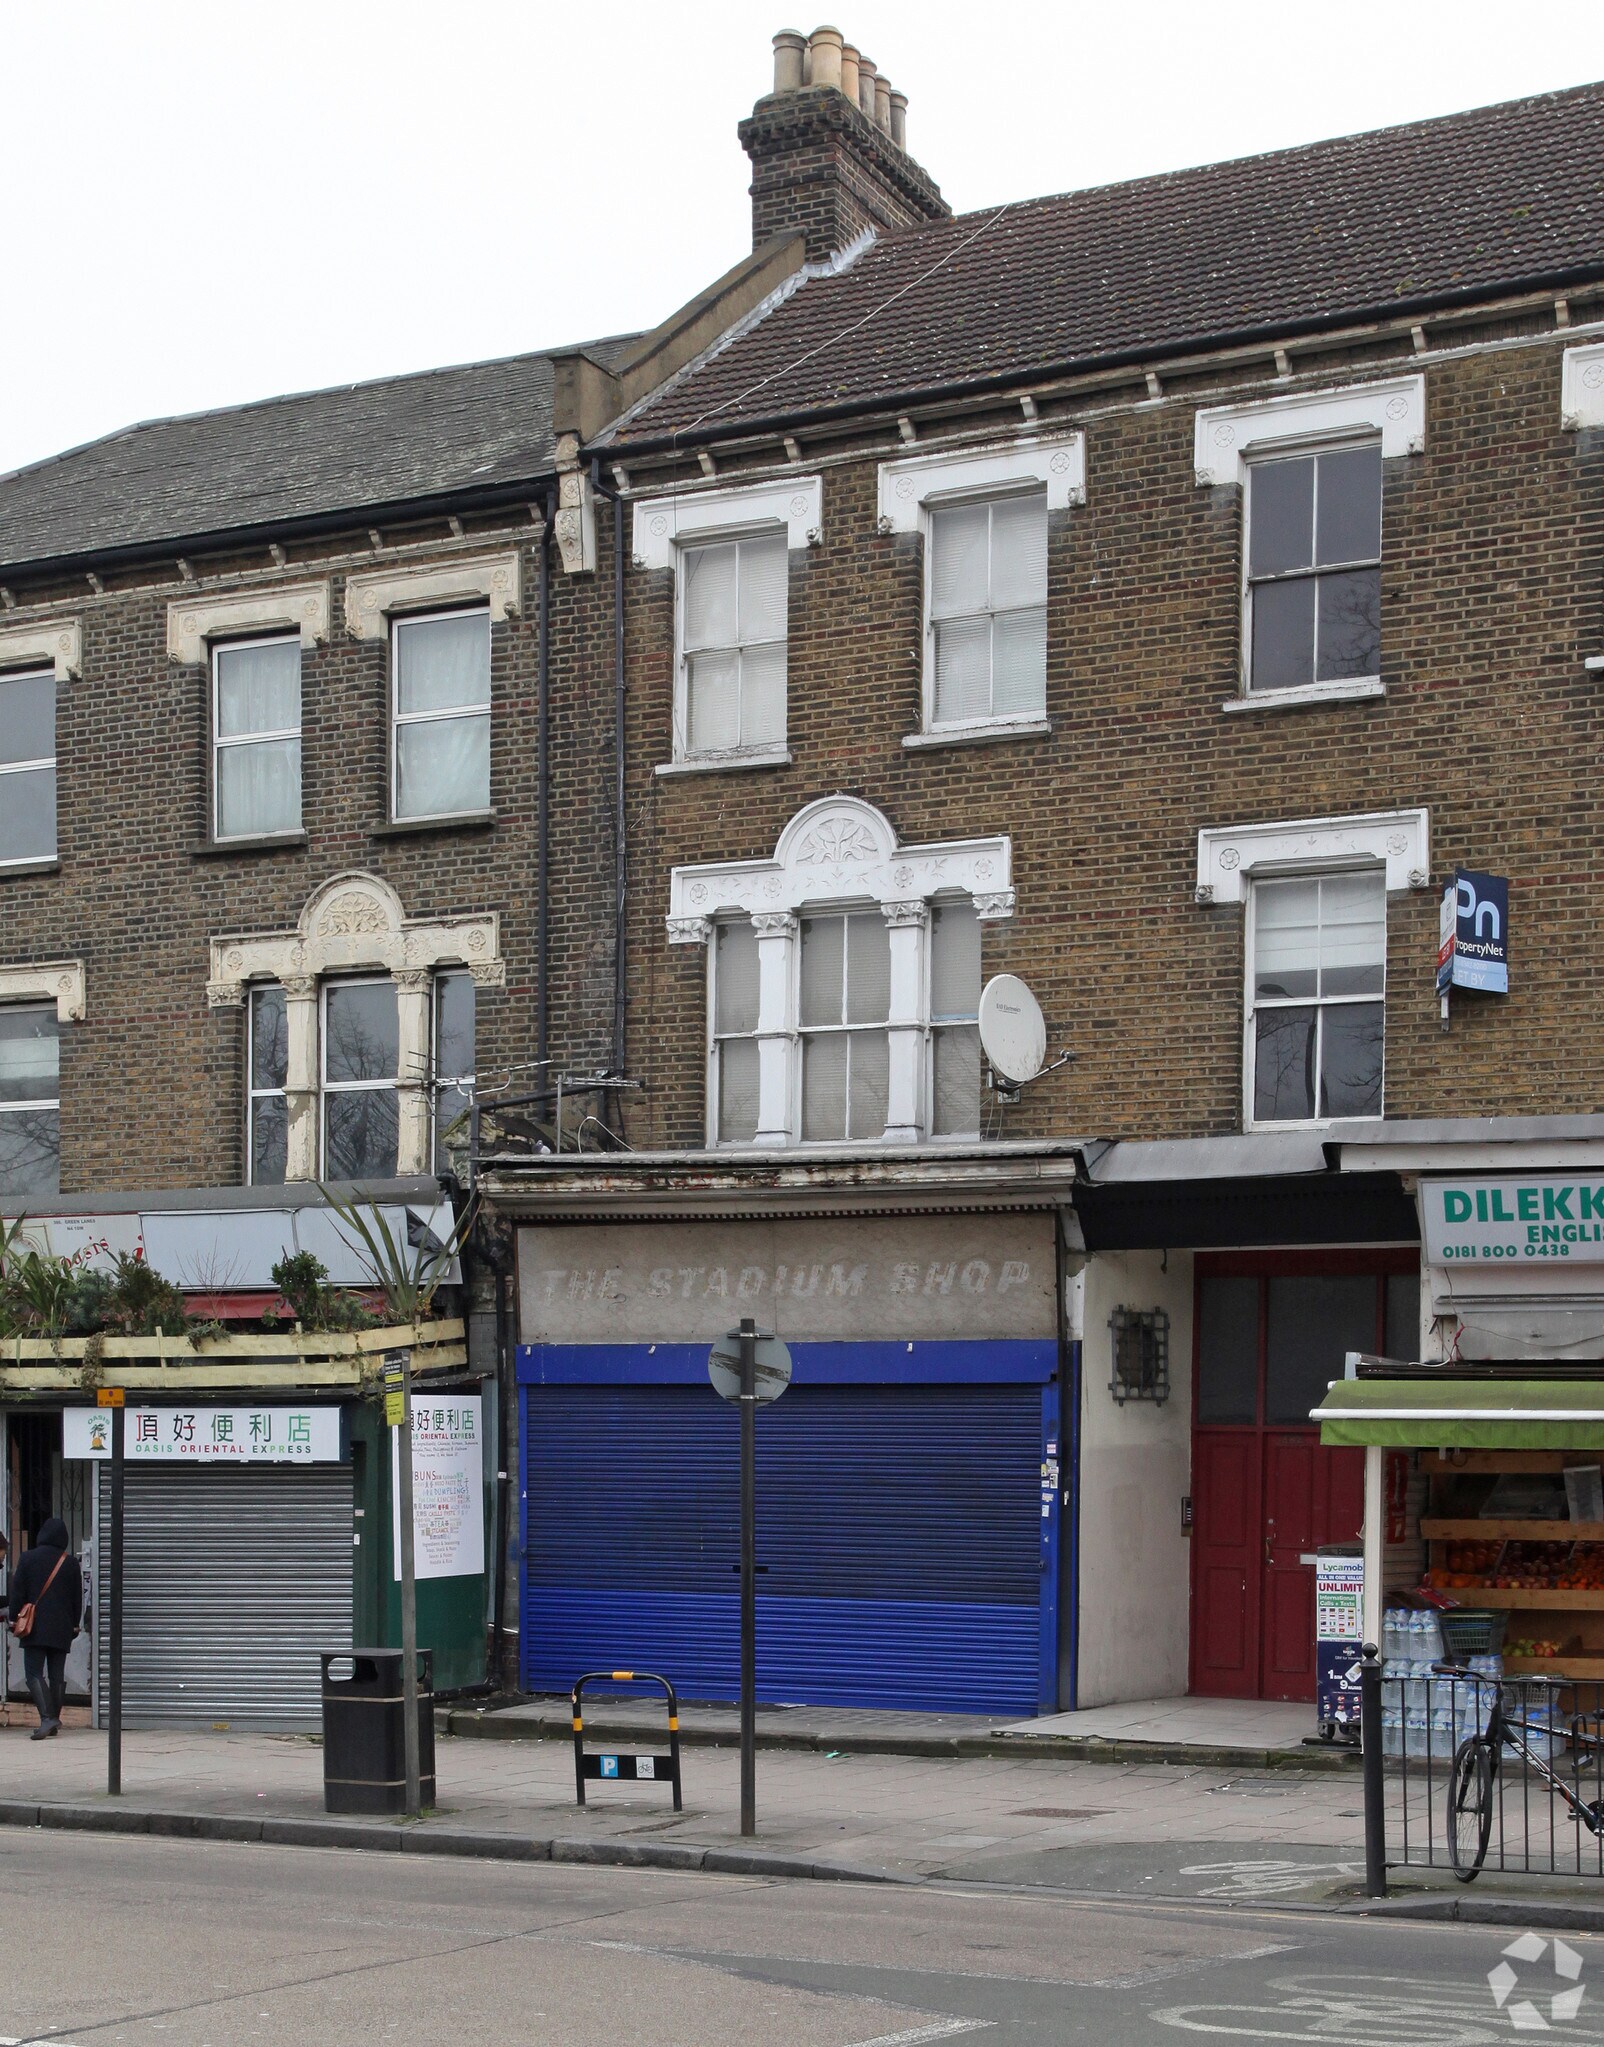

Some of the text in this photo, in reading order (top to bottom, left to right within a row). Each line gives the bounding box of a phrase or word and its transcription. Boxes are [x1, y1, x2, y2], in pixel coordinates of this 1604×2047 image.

[1527, 1224, 1604, 1243] ENGLI
[1442, 1244, 1570, 1258] 0181 800 0438
[542, 1260, 1030, 1300] THE STADIUM SHOP
[88, 1414, 111, 1426] OASIS
[136, 1414, 311, 1443] 頂好便利店
[450, 1432, 475, 1440] EXPRESS
[136, 1445, 311, 1454] OASIS ORIENTAL EXPRESS
[414, 1470, 436, 1481] BUNS
[434, 1486, 469, 1495] DUMPLINGS
[1327, 1669, 1334, 1680] 1
[1339, 1679, 1349, 1690] 9
[603, 1757, 616, 1775] P
